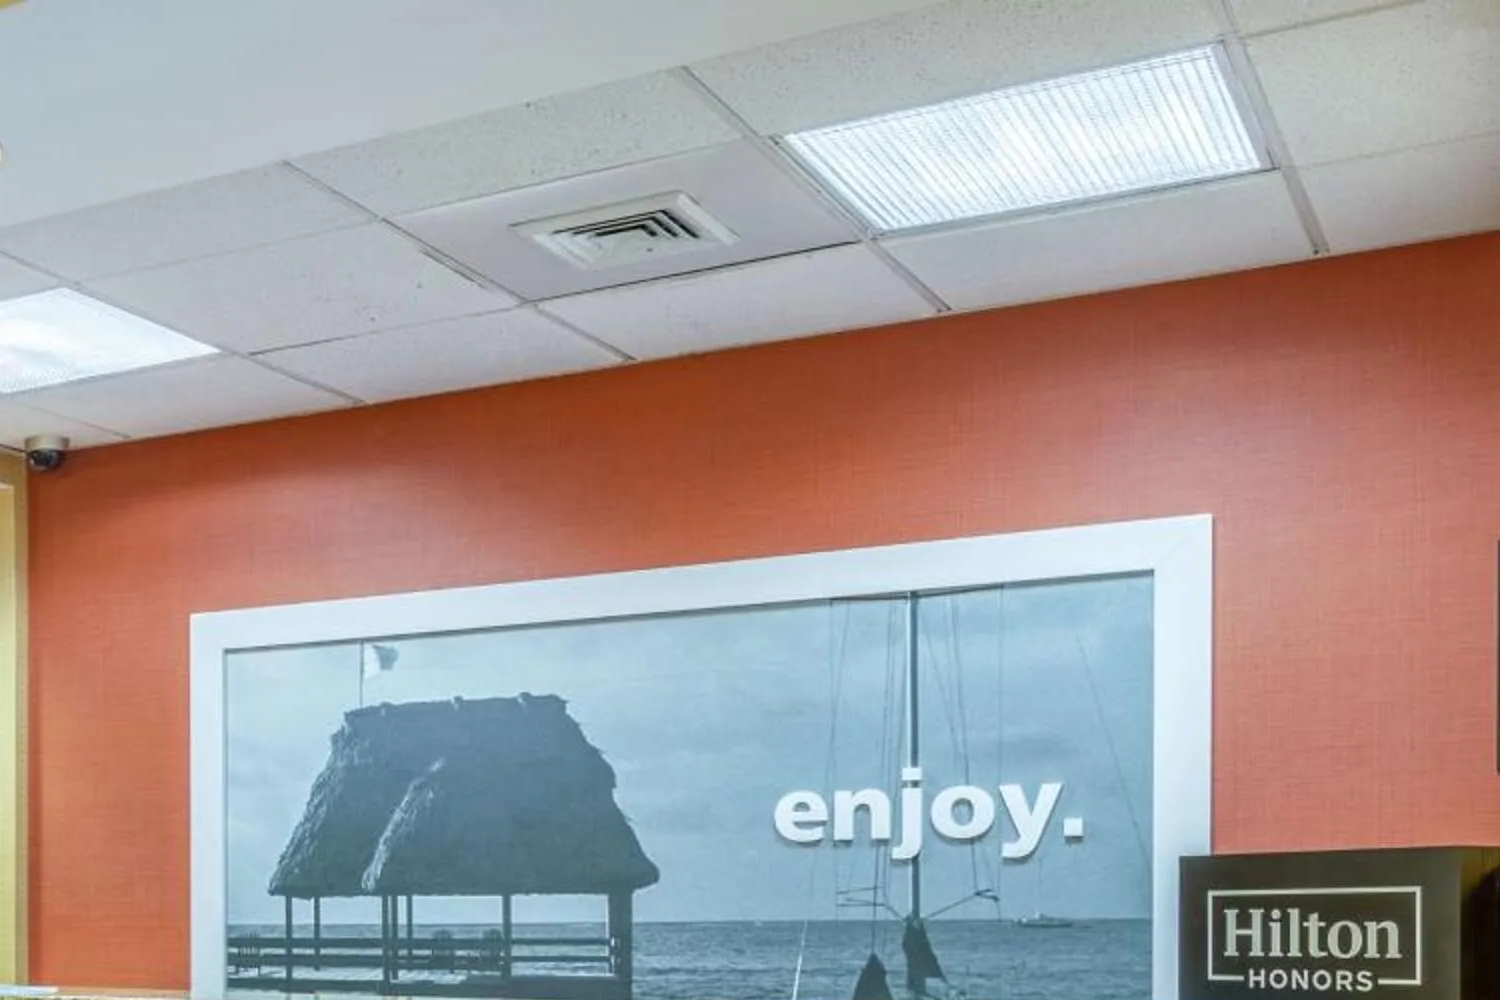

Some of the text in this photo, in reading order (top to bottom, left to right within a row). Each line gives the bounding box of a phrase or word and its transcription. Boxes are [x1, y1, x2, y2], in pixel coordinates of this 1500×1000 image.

[774, 767, 1084, 860] enjoy.
[1223, 907, 1402, 959] Hilton
[1248, 968, 1373, 992] HONORS
